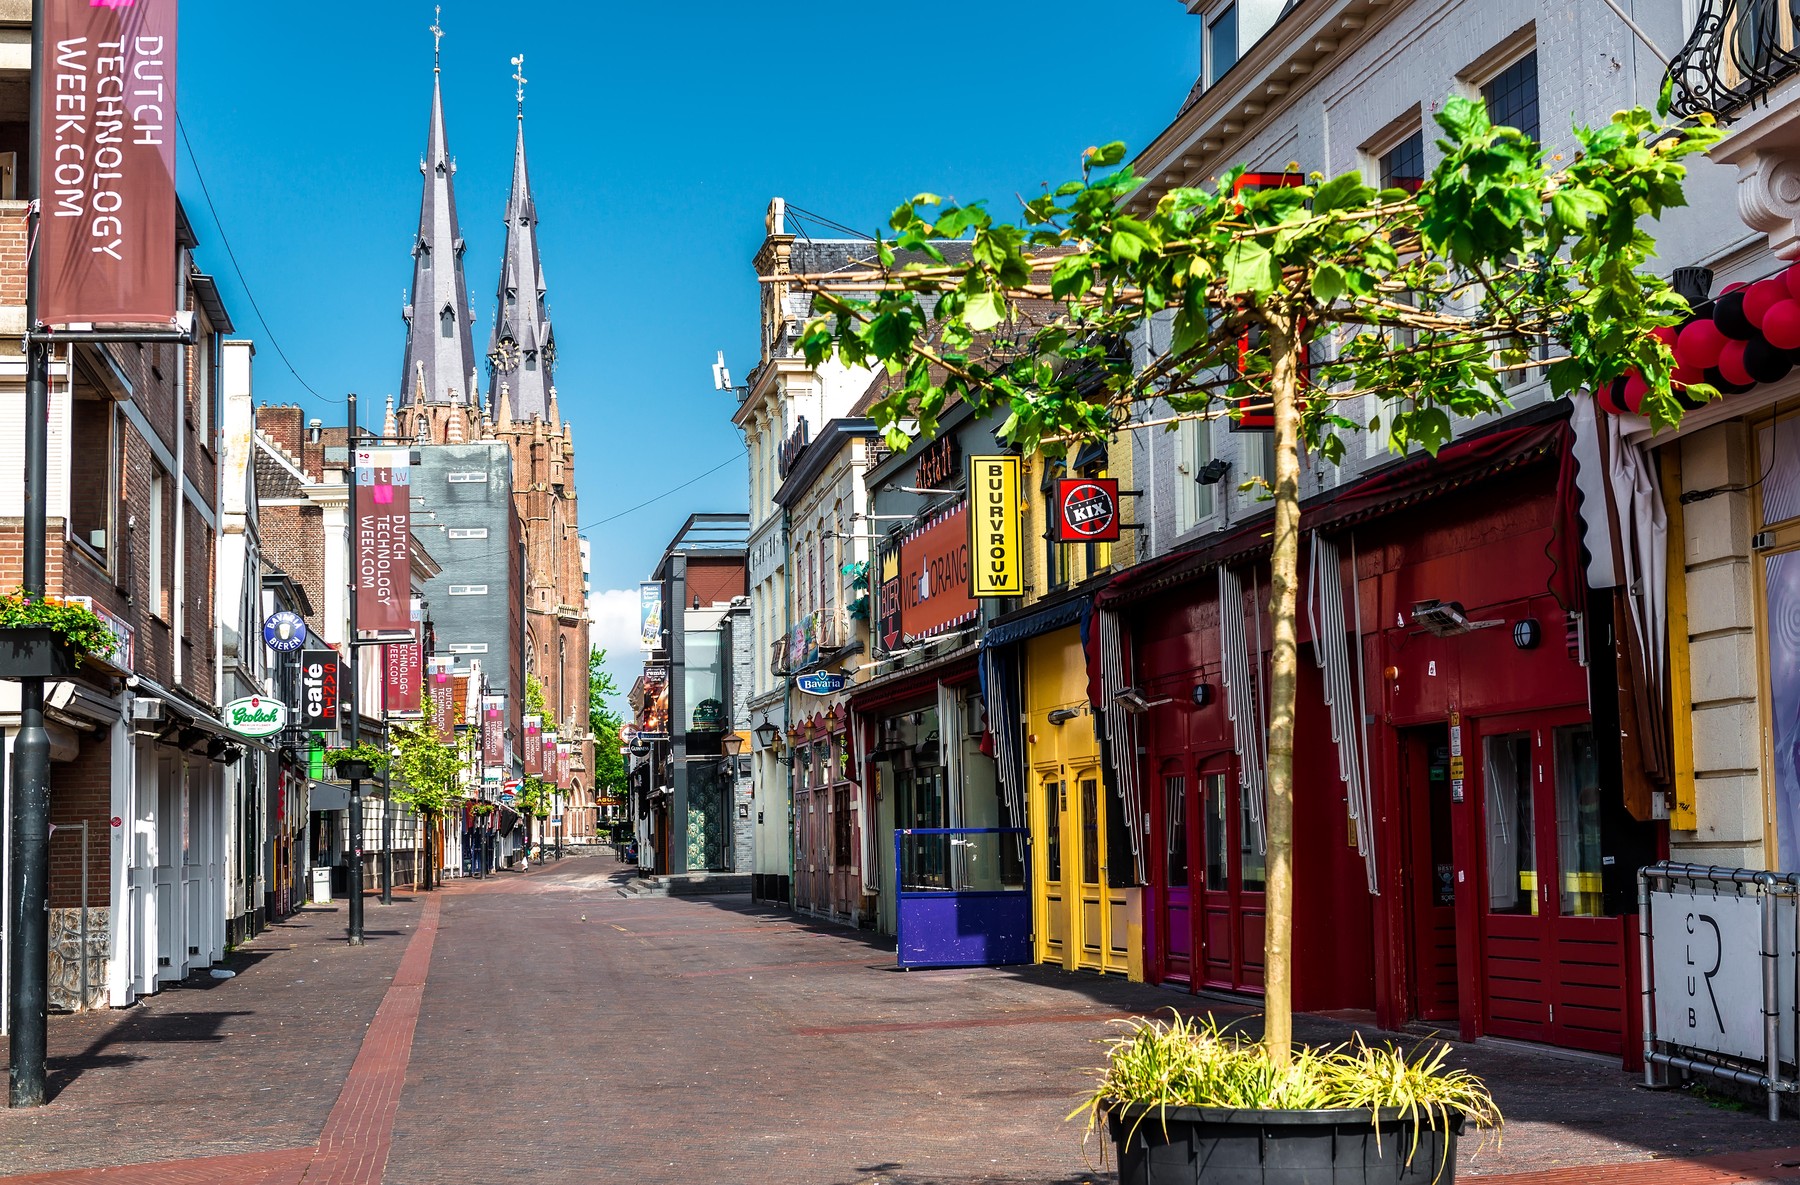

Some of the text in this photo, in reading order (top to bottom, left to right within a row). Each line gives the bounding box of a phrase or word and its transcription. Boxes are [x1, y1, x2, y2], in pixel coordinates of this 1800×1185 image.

[133, 36, 163, 145] DUTCH
[54, 37, 87, 217] WEEK.COM
[92, 34, 125, 261] TECHNOLOGY
[393, 515, 406, 560] DUTCH
[988, 465, 1009, 587] BUURVROUW
[1073, 502, 1107, 522] KIX
[361, 515, 375, 588] WEEK.COM
[377, 515, 391, 606] TECHNOLOGY
[902, 543, 967, 611] WE ORANG
[267, 612, 303, 630] BAVARIA
[881, 578, 900, 619] BIER
[269, 636, 301, 650] BIEREN
[399, 644, 409, 696] ECHNOLOGY
[303, 663, 323, 717] café
[445, 687, 453, 710] DUTCH
[804, 679, 840, 689] Bavaria
[232, 707, 279, 725] Grolsch
[1686, 912, 1697, 1029] CLUB
[1698, 914, 1725, 1034] R
